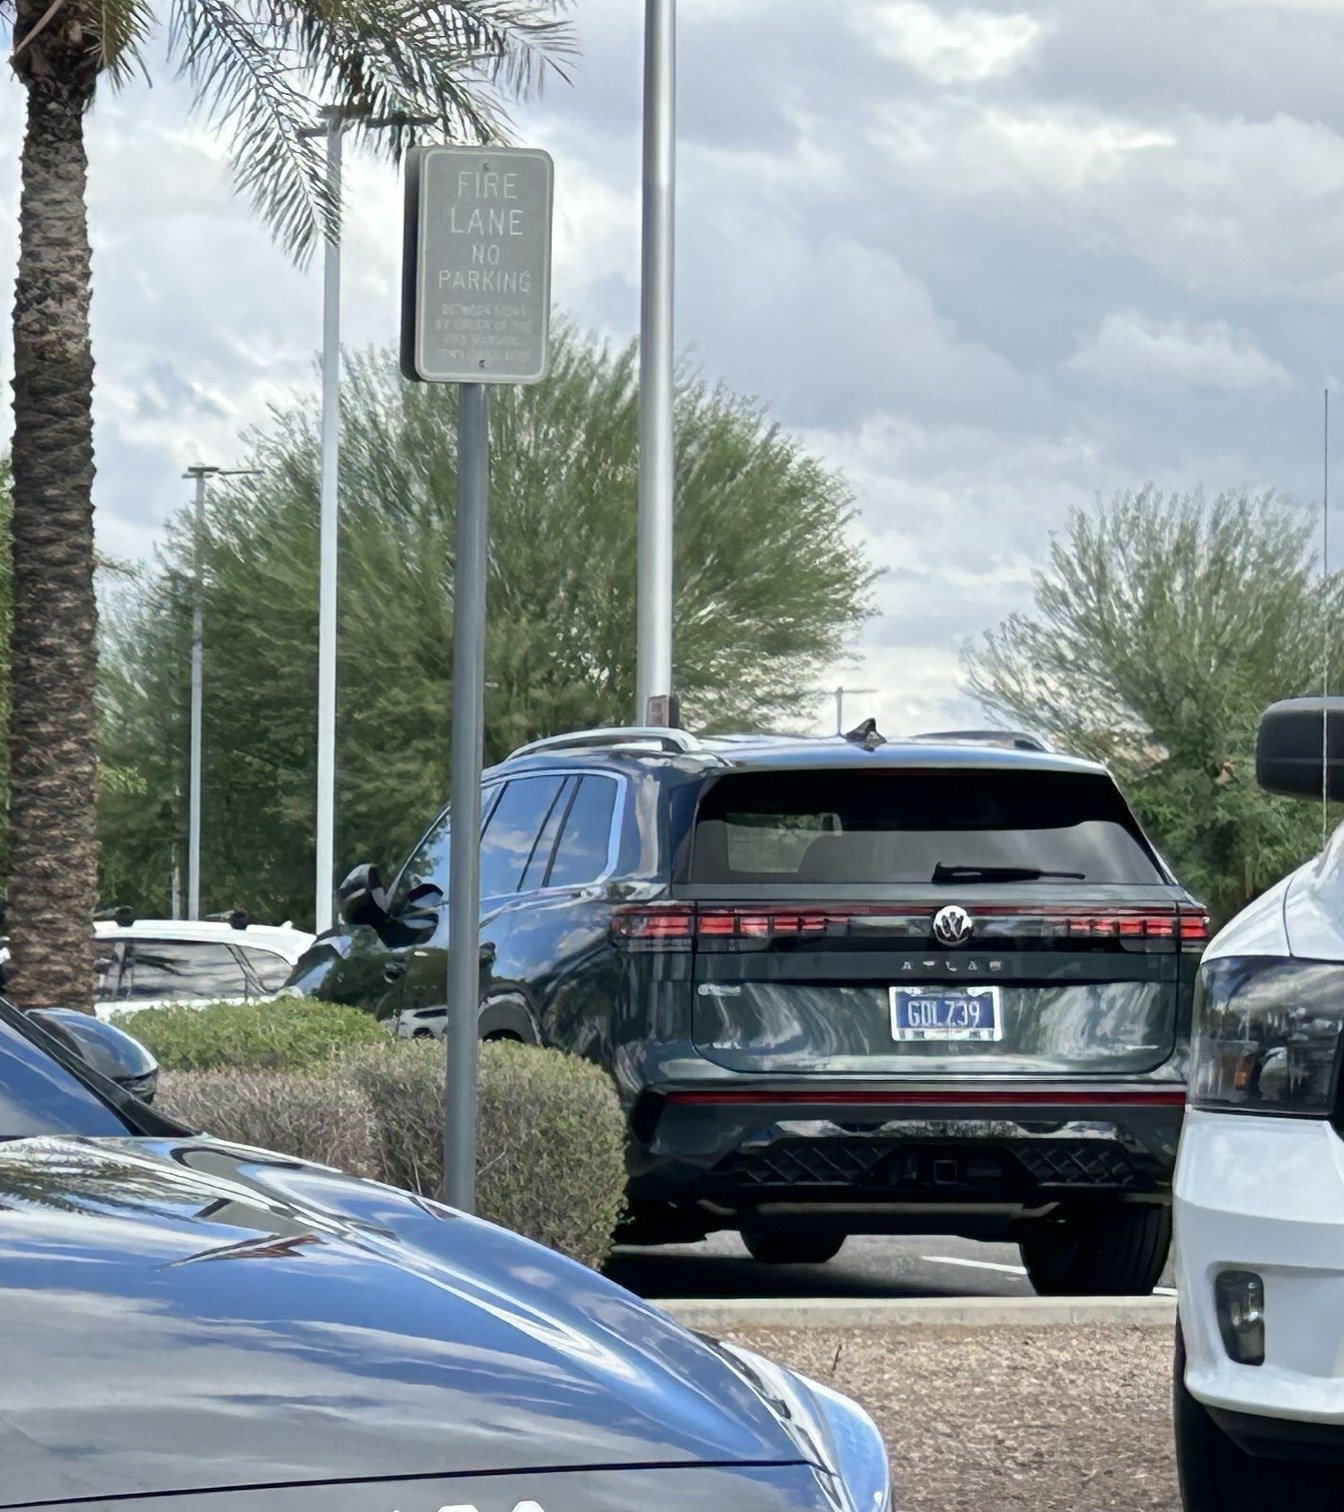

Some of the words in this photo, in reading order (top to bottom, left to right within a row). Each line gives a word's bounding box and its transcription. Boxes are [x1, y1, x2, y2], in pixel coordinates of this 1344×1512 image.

[458, 171, 518, 199] FIRE
[451, 207, 524, 236] LANE
[472, 244, 500, 265] NO
[438, 269, 531, 292] PARKING
